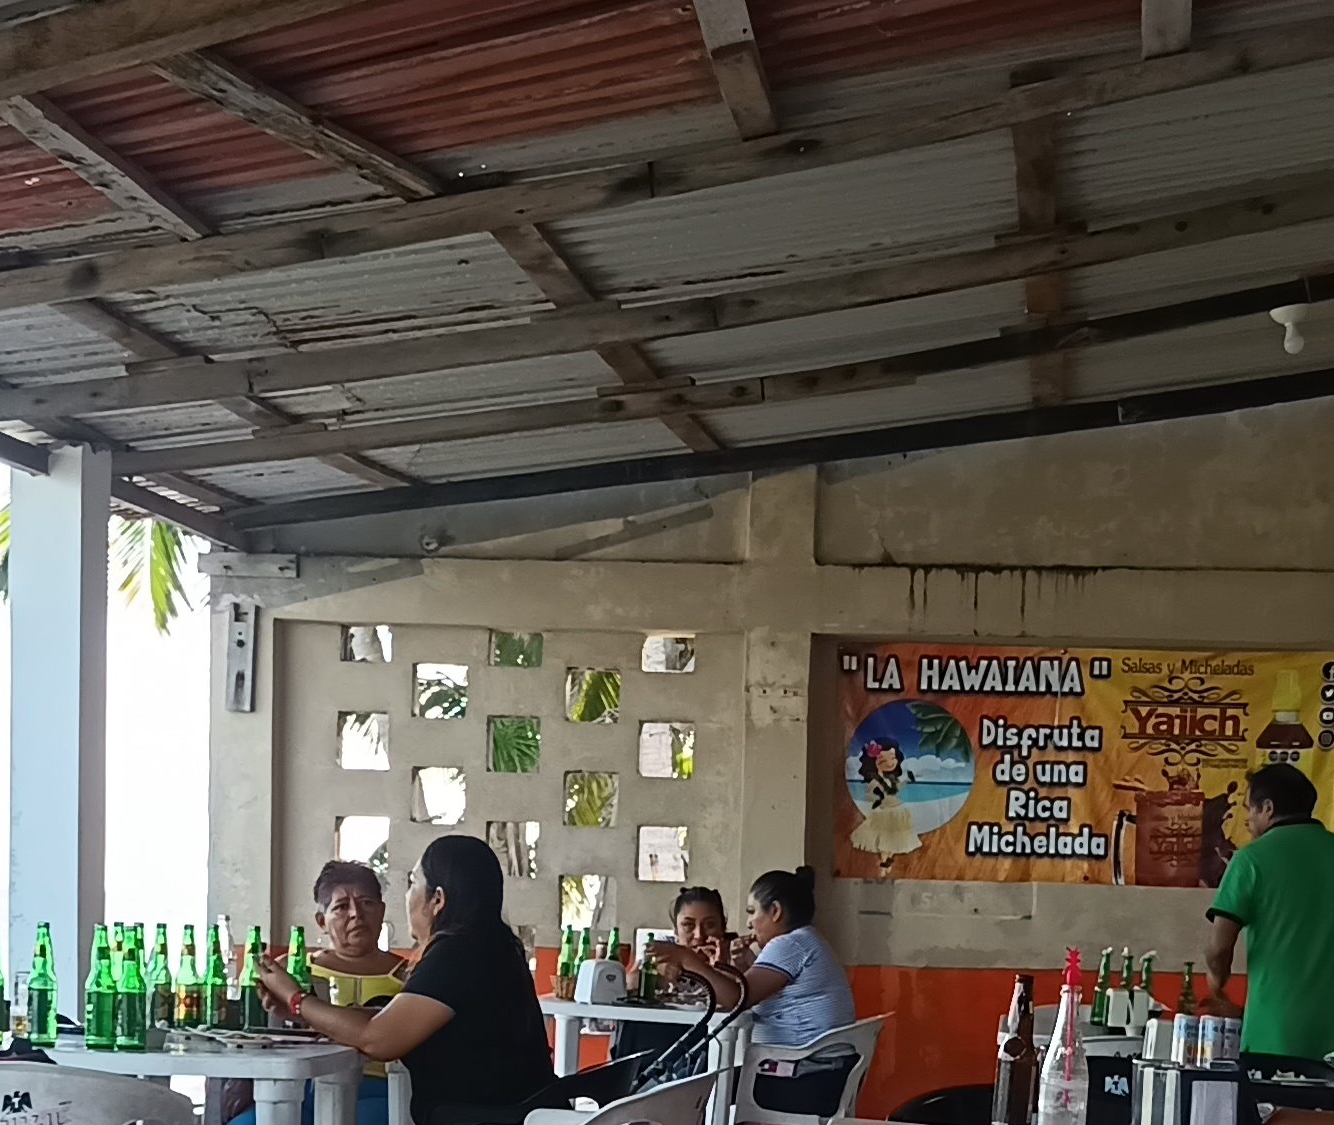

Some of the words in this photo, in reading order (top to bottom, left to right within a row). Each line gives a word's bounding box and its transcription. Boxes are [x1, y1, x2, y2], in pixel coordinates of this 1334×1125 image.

[1121, 656, 1163, 674] Salsas
[1167, 662, 1175, 677] y
[1180, 658, 1255, 676] Micheladas
[982, 717, 1100, 757] Disfruta
[995, 754, 1027, 783] de
[1035, 763, 1085, 784] una
[1008, 789, 1069, 819] Rica
[967, 824, 1106, 855] Michelada
